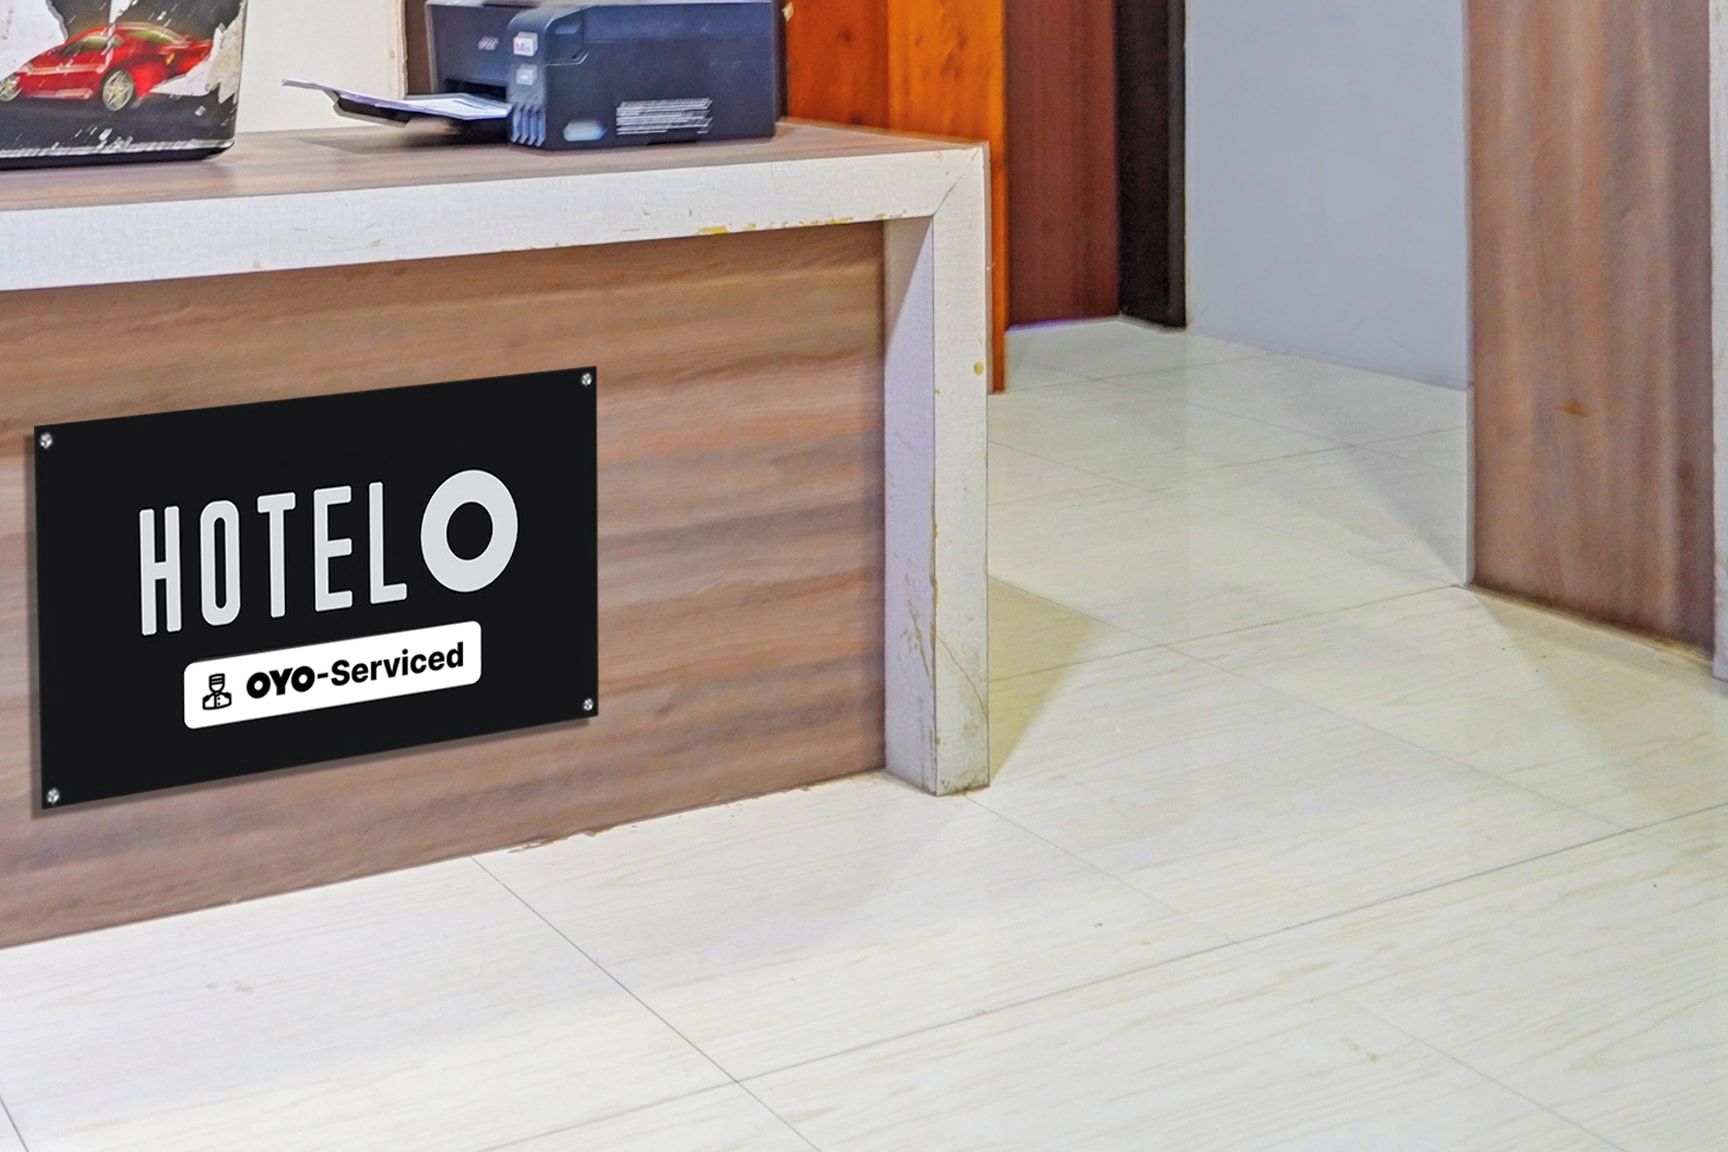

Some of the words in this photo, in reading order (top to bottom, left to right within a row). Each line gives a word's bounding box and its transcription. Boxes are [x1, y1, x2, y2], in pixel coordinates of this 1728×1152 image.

[139, 481, 407, 636] HOTEL
[420, 469, 519, 593] O
[246, 641, 464, 700] OYO-Serviced
